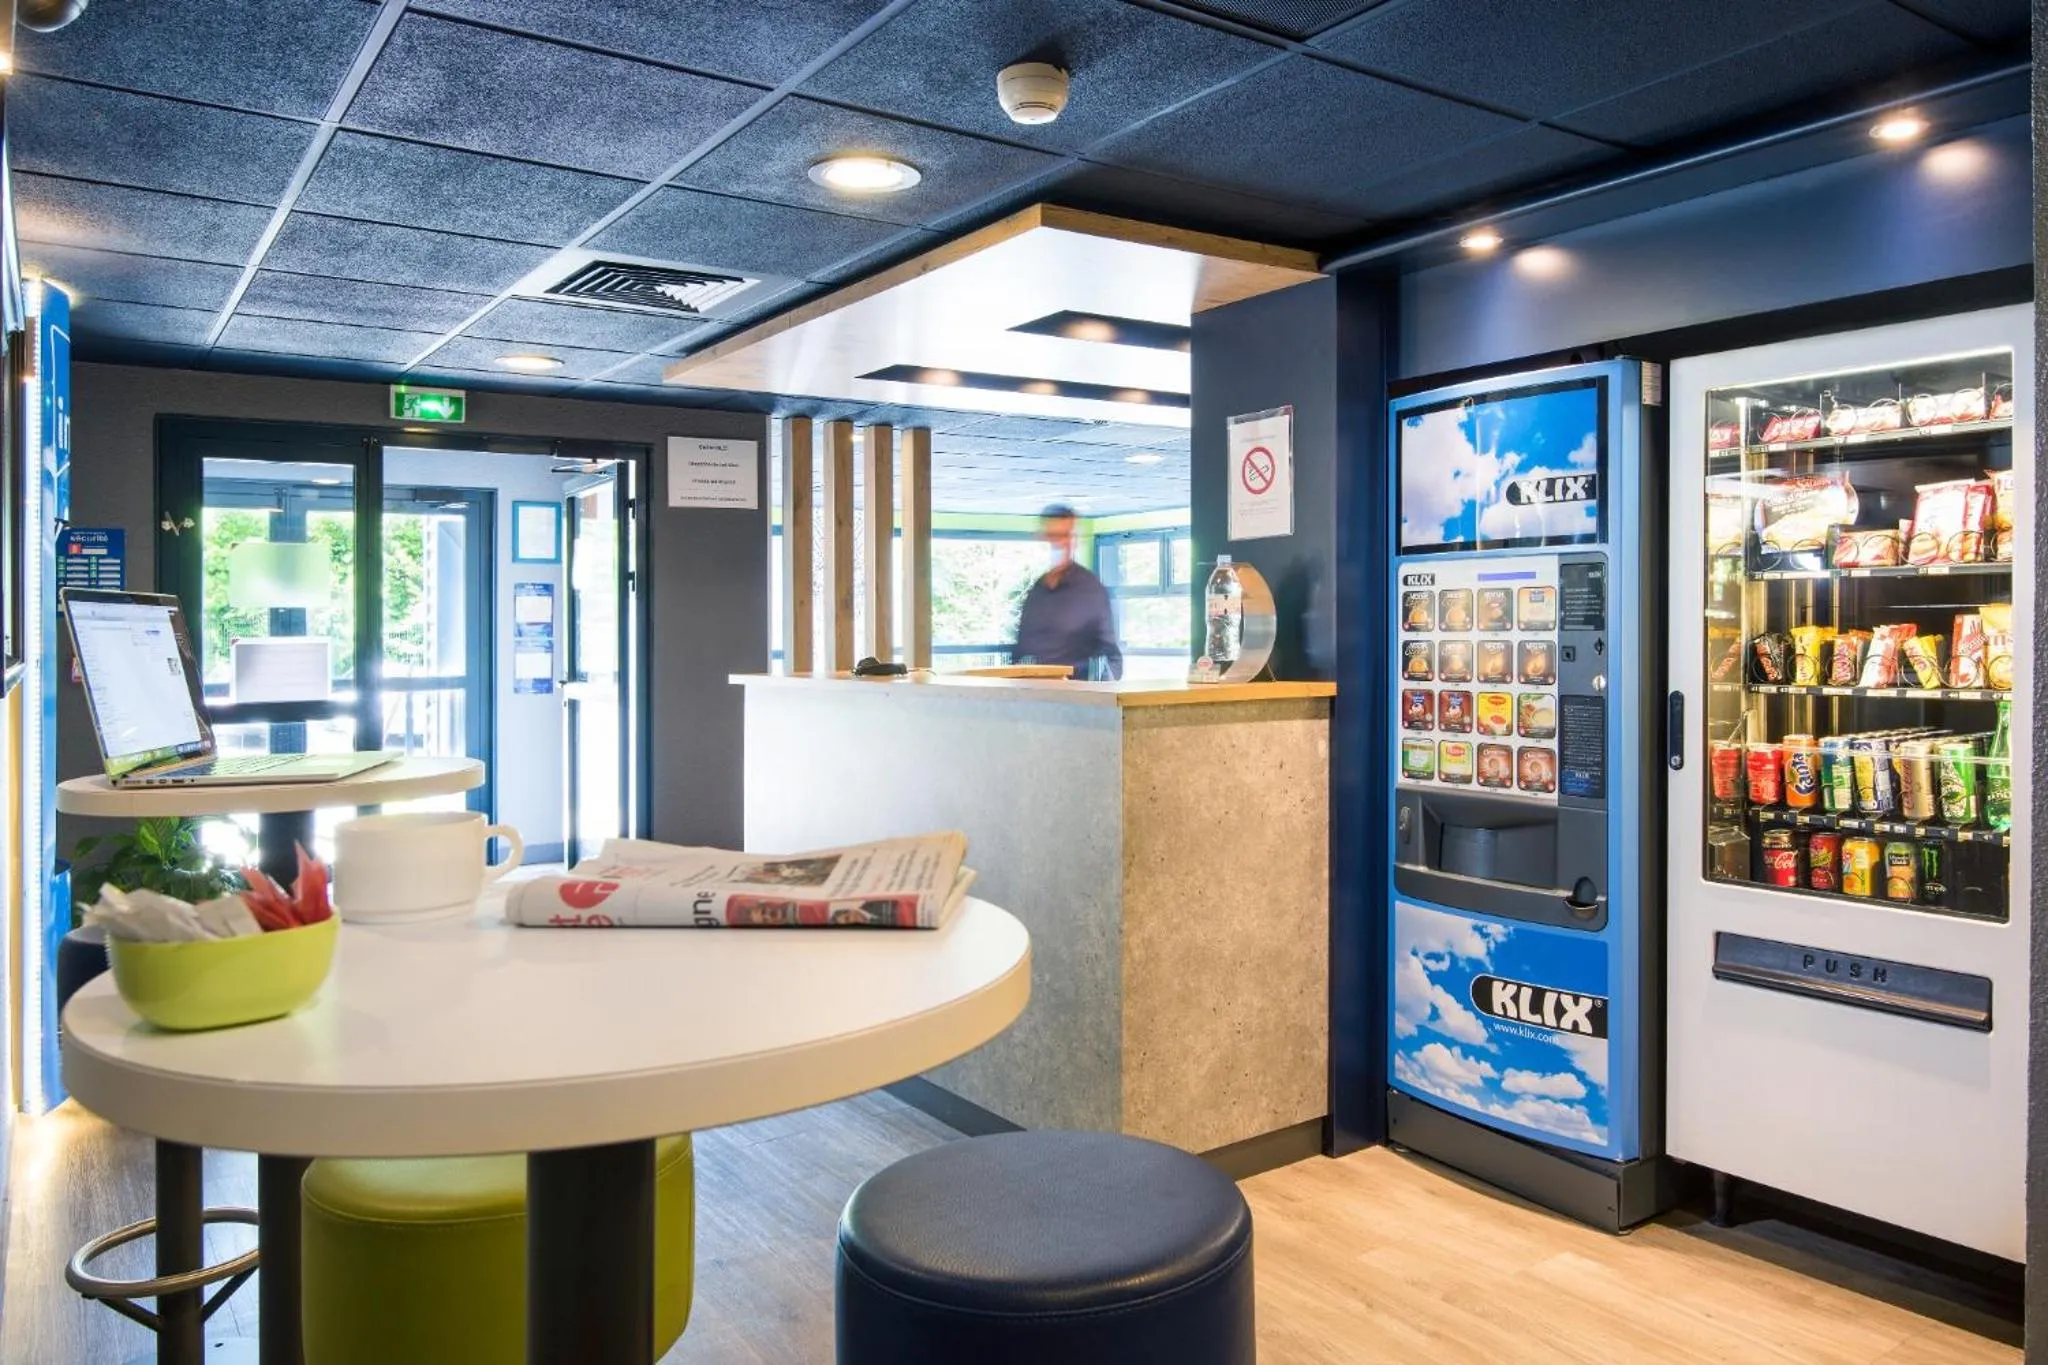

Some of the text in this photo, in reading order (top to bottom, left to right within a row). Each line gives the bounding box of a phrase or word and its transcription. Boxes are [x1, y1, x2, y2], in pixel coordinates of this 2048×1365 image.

[1518, 478, 1588, 504] KLIX
[1407, 573, 1432, 586] KLIX
[1802, 953, 1889, 983] PUSH
[1491, 980, 1594, 1034] KLIX
[1492, 1022, 1560, 1044] www.klix.com
